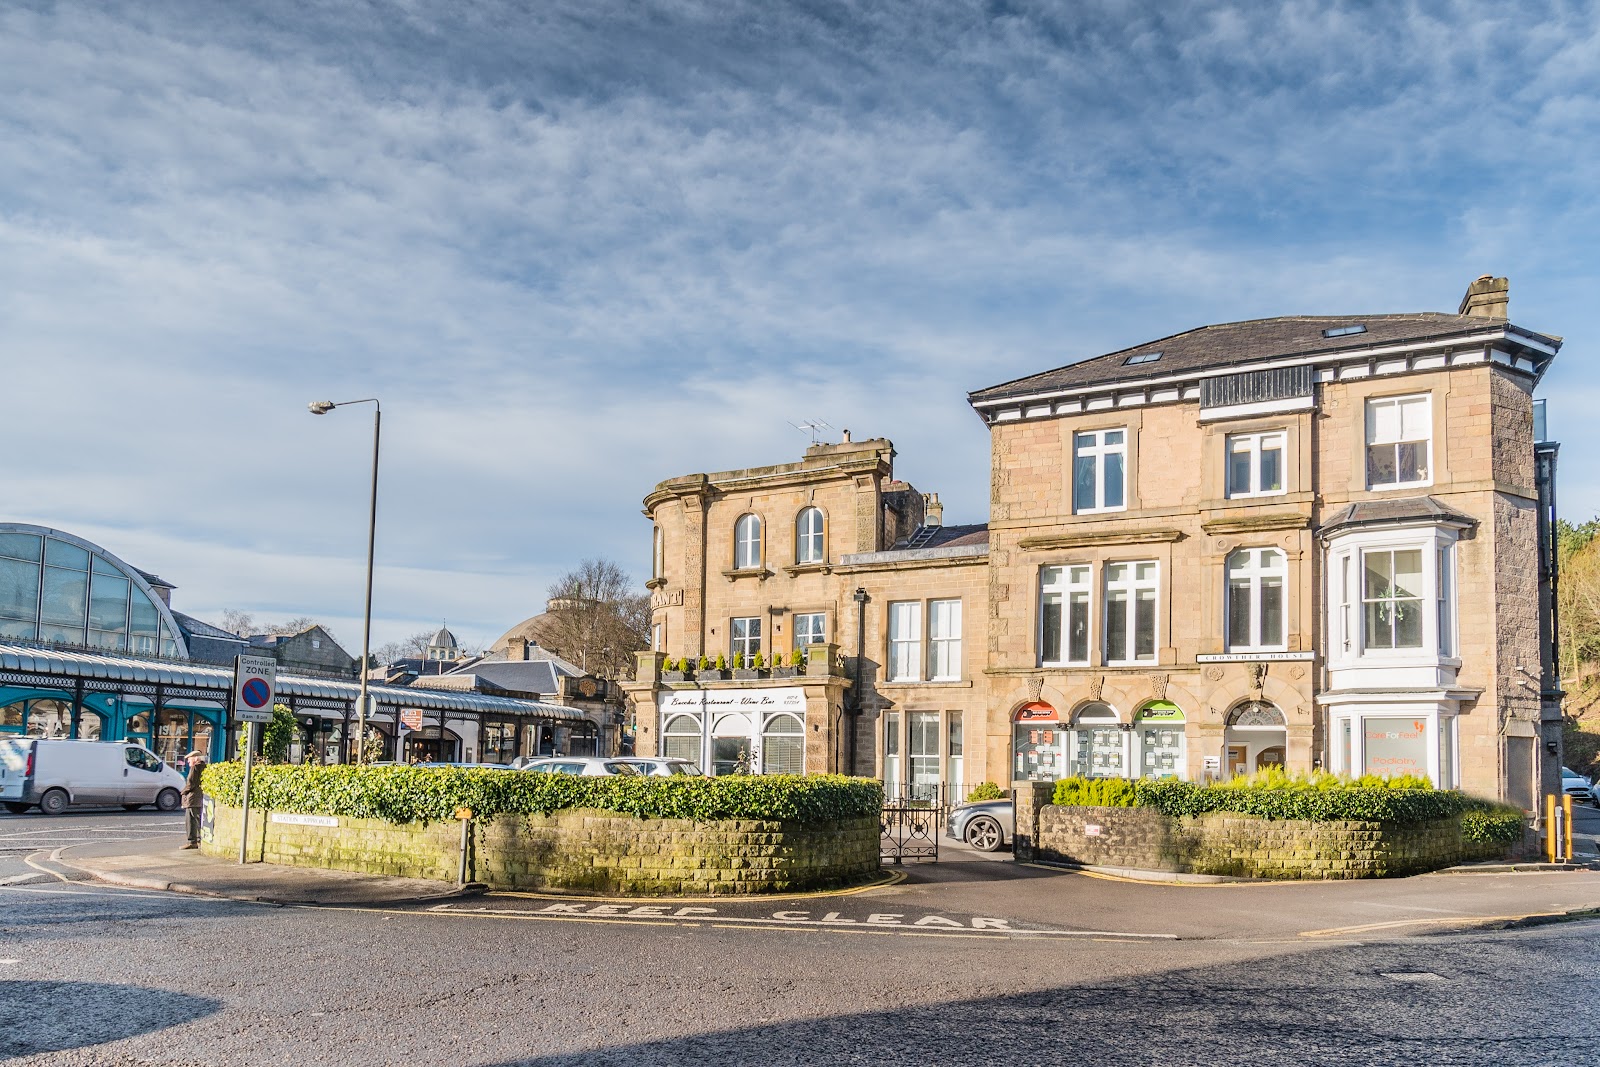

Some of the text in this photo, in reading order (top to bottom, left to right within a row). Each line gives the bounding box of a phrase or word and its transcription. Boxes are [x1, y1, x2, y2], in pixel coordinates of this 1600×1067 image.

[241, 658, 275, 667] Controlled
[246, 667, 270, 675] ZONE
[699, 697, 734, 706] Restaurant
[740, 697, 759, 705] Wine
[760, 696, 775, 705] Bar
[1372, 756, 1417, 765] Podiatry
[539, 903, 1012, 929] KEEP CLEAR
